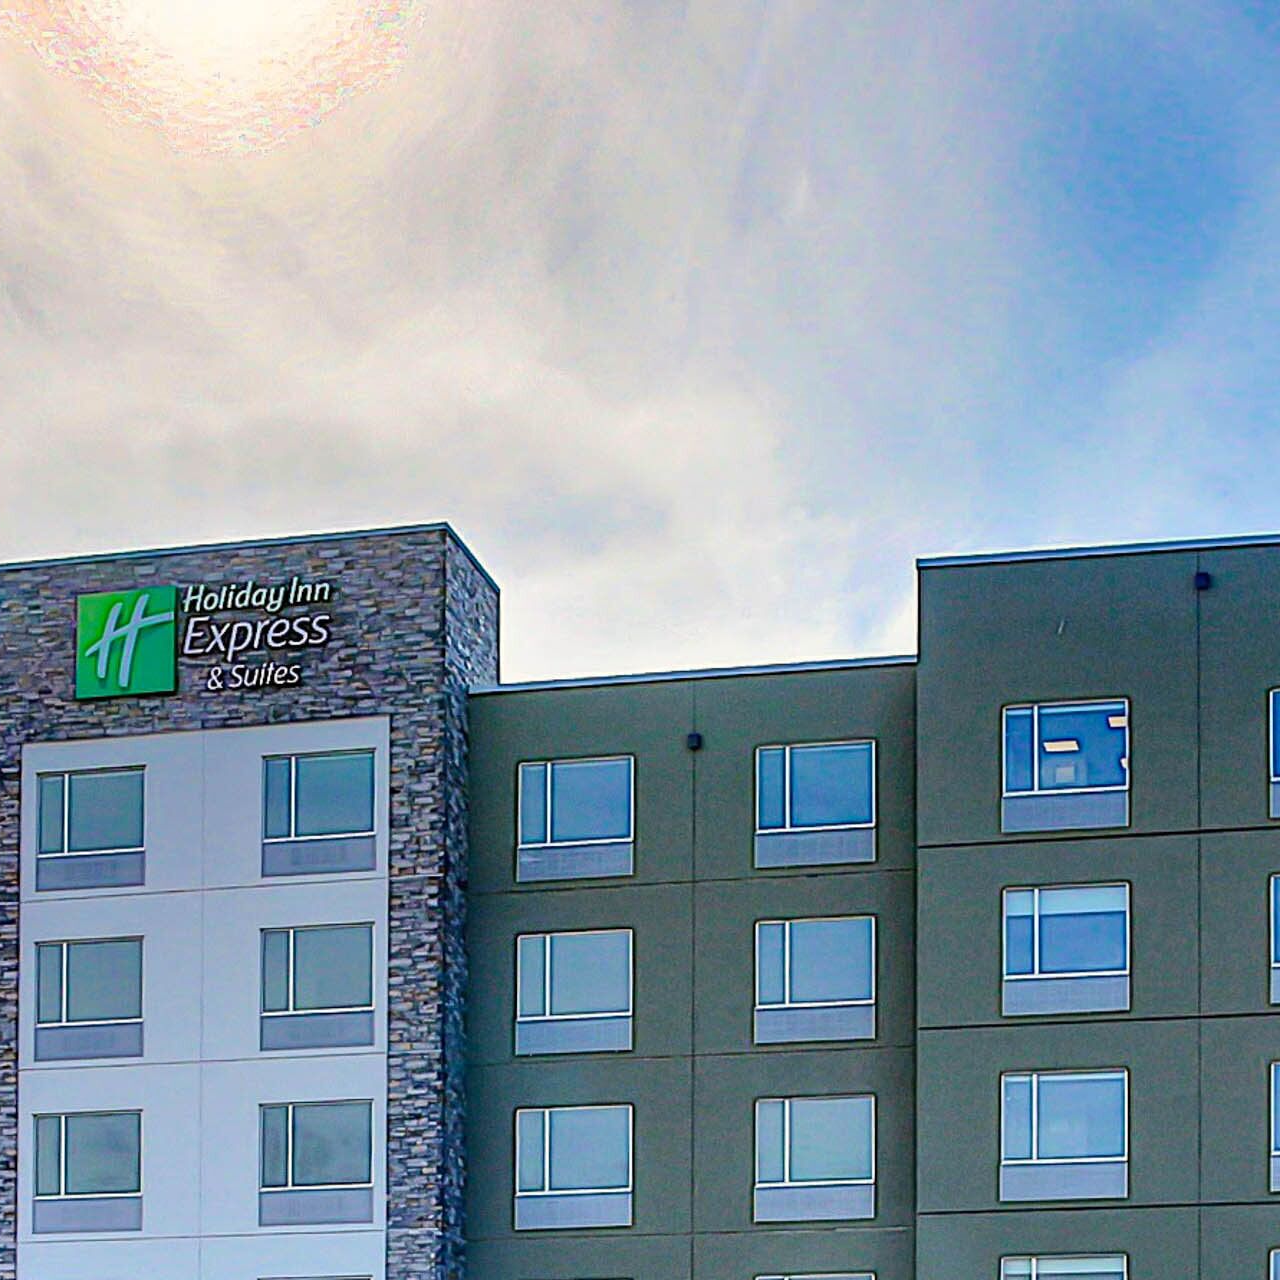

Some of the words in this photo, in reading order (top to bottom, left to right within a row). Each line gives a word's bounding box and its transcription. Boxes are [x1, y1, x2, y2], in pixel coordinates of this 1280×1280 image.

[183, 580, 285, 613] Holiday
[290, 576, 330, 604] Inn
[183, 615, 330, 662] Express
[207, 666, 224, 690] &
[228, 662, 301, 688] Suites
